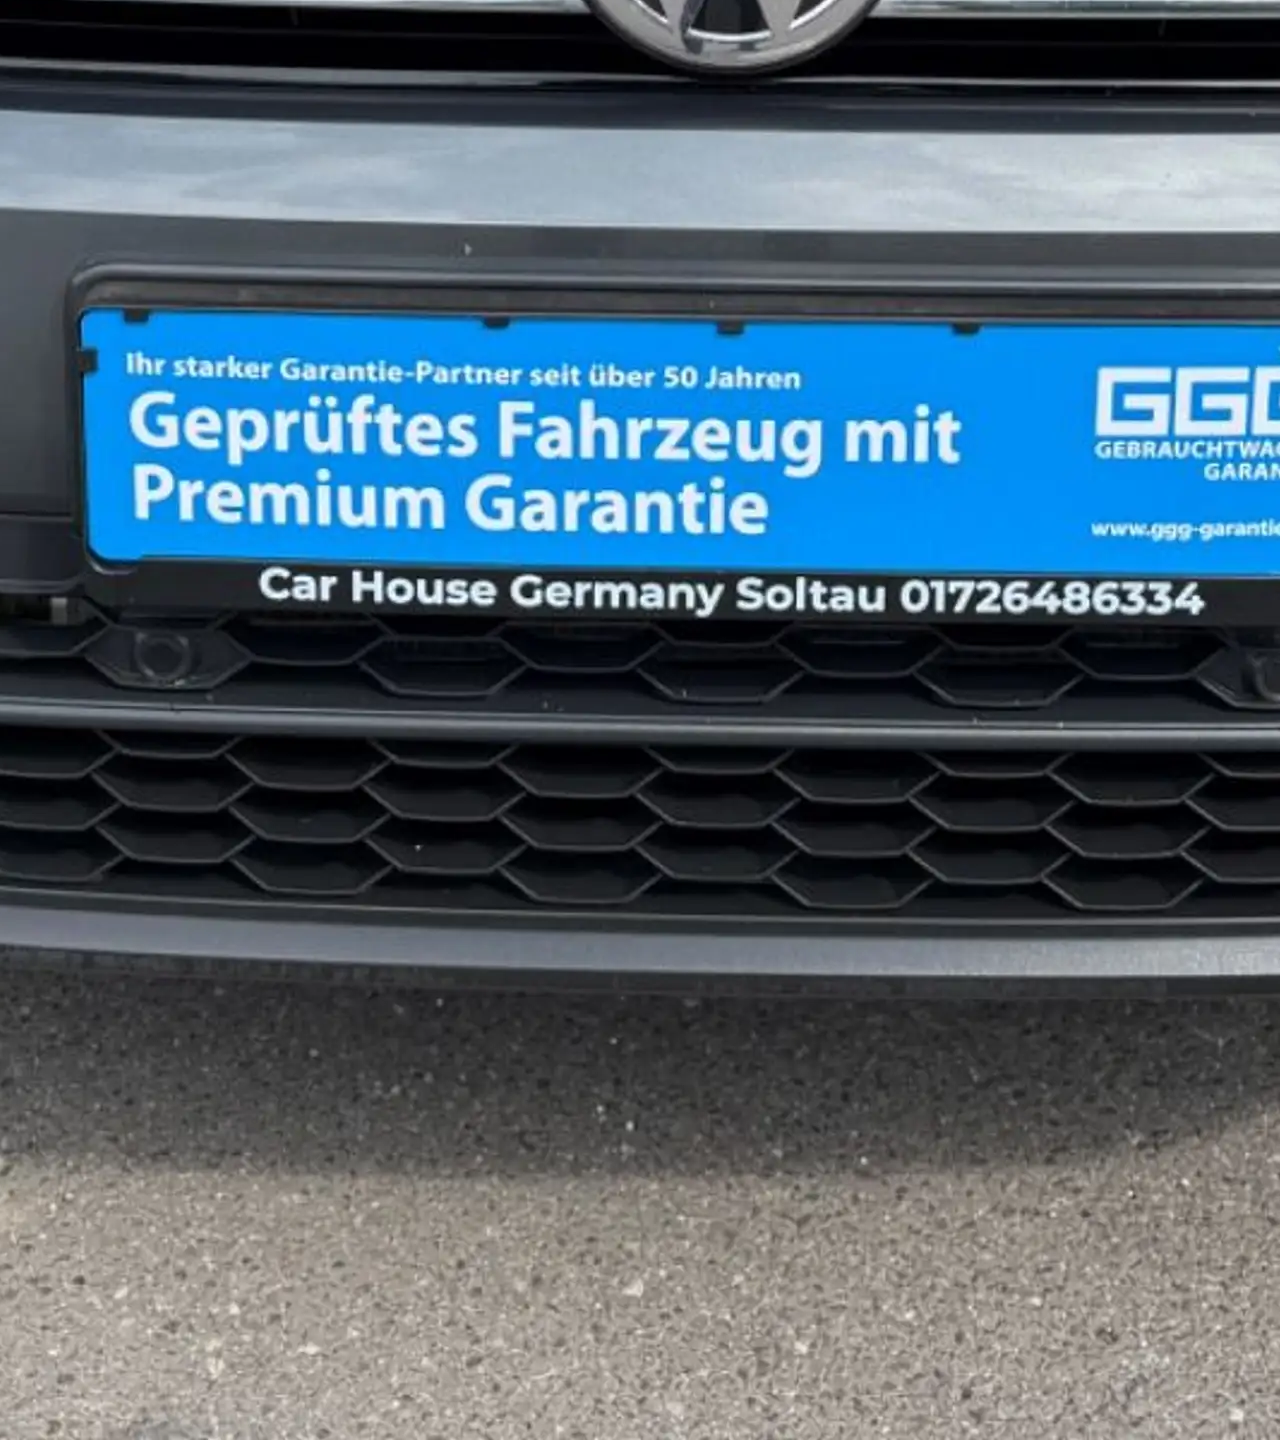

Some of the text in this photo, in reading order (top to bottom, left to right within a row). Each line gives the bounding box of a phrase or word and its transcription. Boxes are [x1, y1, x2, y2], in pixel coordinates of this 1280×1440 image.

[125, 352, 802, 391] Ihr starker Garantie-Partner seit über 50 Jahren
[128, 390, 963, 478] Geprüftes Fahrzeug mit
[131, 463, 769, 535] Premium Garantie
[258, 566, 1206, 618] Car House Germany Soltau 01726486334
